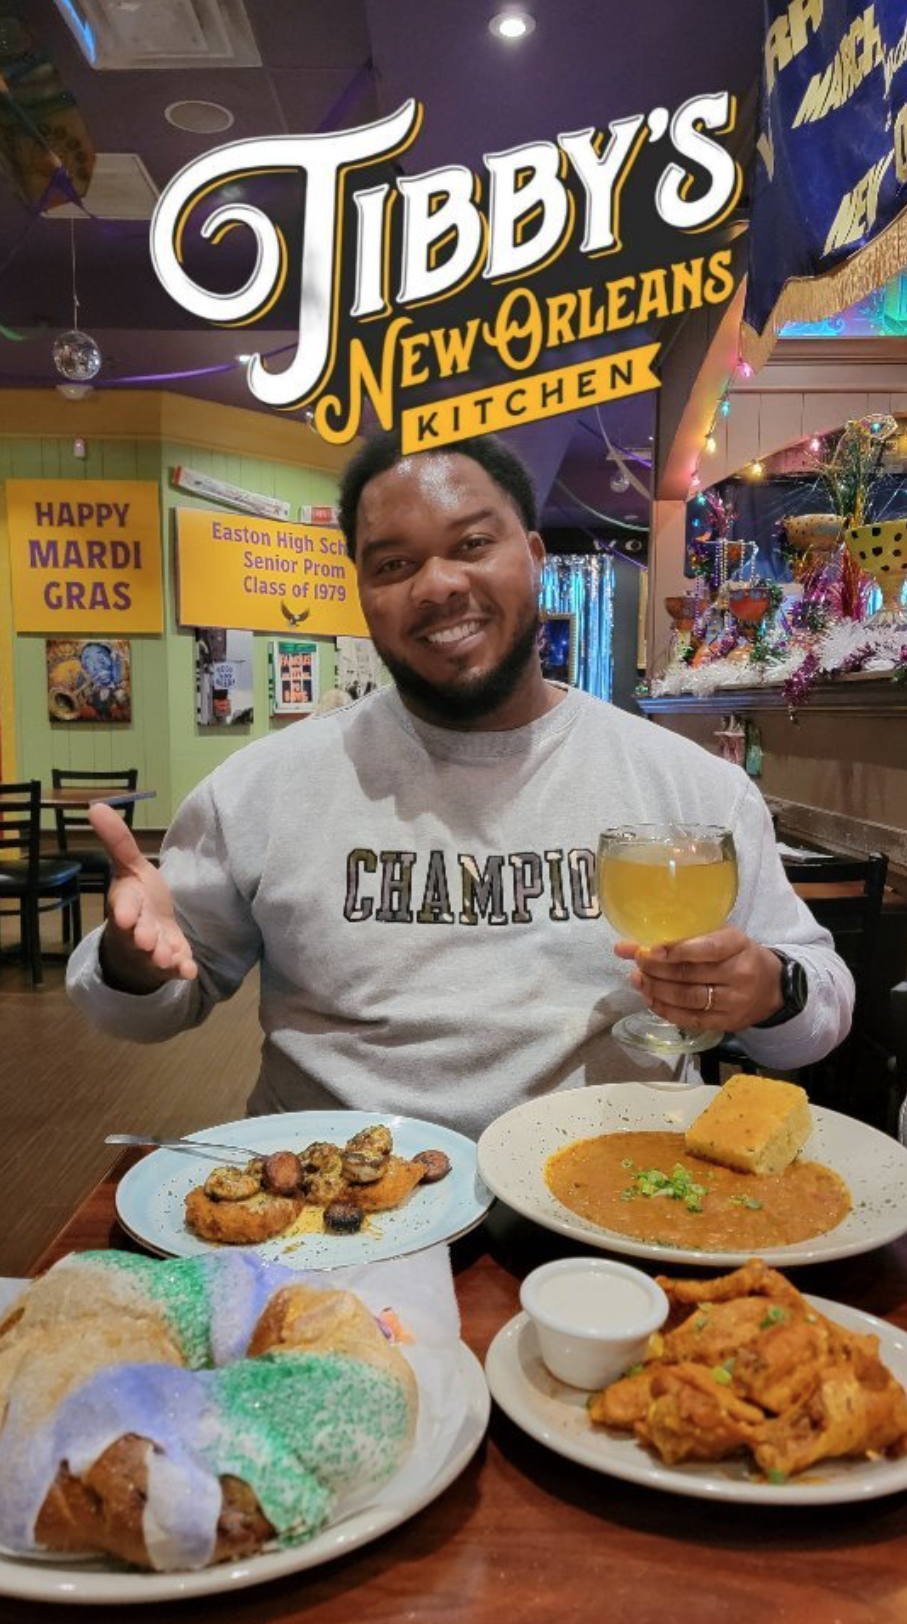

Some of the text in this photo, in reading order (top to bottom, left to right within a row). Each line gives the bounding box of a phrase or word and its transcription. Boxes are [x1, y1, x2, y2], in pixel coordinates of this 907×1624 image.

[35, 502, 130, 528] HAPPY
[212, 522, 271, 547] Easton
[276, 528, 314, 553] High
[29, 540, 141, 569] MARDI
[244, 551, 346, 579] Senior Prom
[43, 582, 131, 610] GRAS
[243, 576, 346, 602] Class of 1979
[343, 848, 602, 925] CHAMPIO
